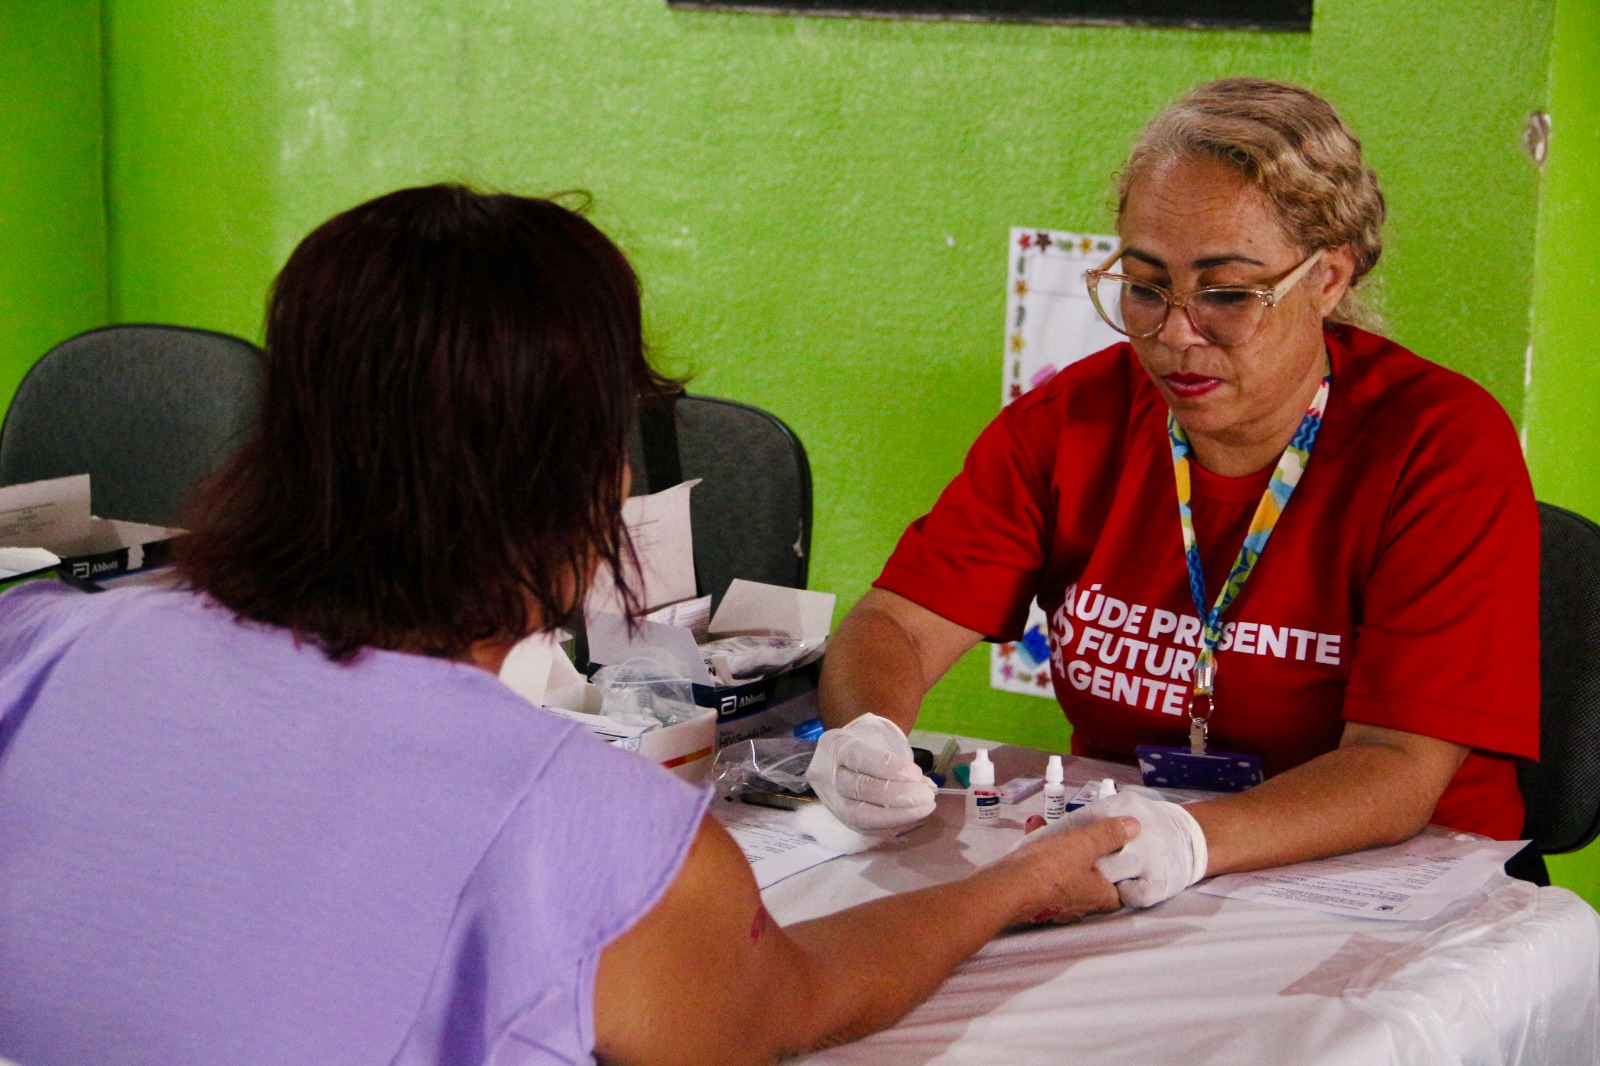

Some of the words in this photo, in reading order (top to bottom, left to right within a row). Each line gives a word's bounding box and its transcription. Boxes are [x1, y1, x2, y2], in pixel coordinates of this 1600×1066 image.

[92, 560, 118, 574] Abbott
[1065, 583, 1147, 634] AÚDE
[1076, 626, 1217, 682] FUTUR
[738, 693, 765, 708] Abbott
[1067, 660, 1187, 717] GENTE
